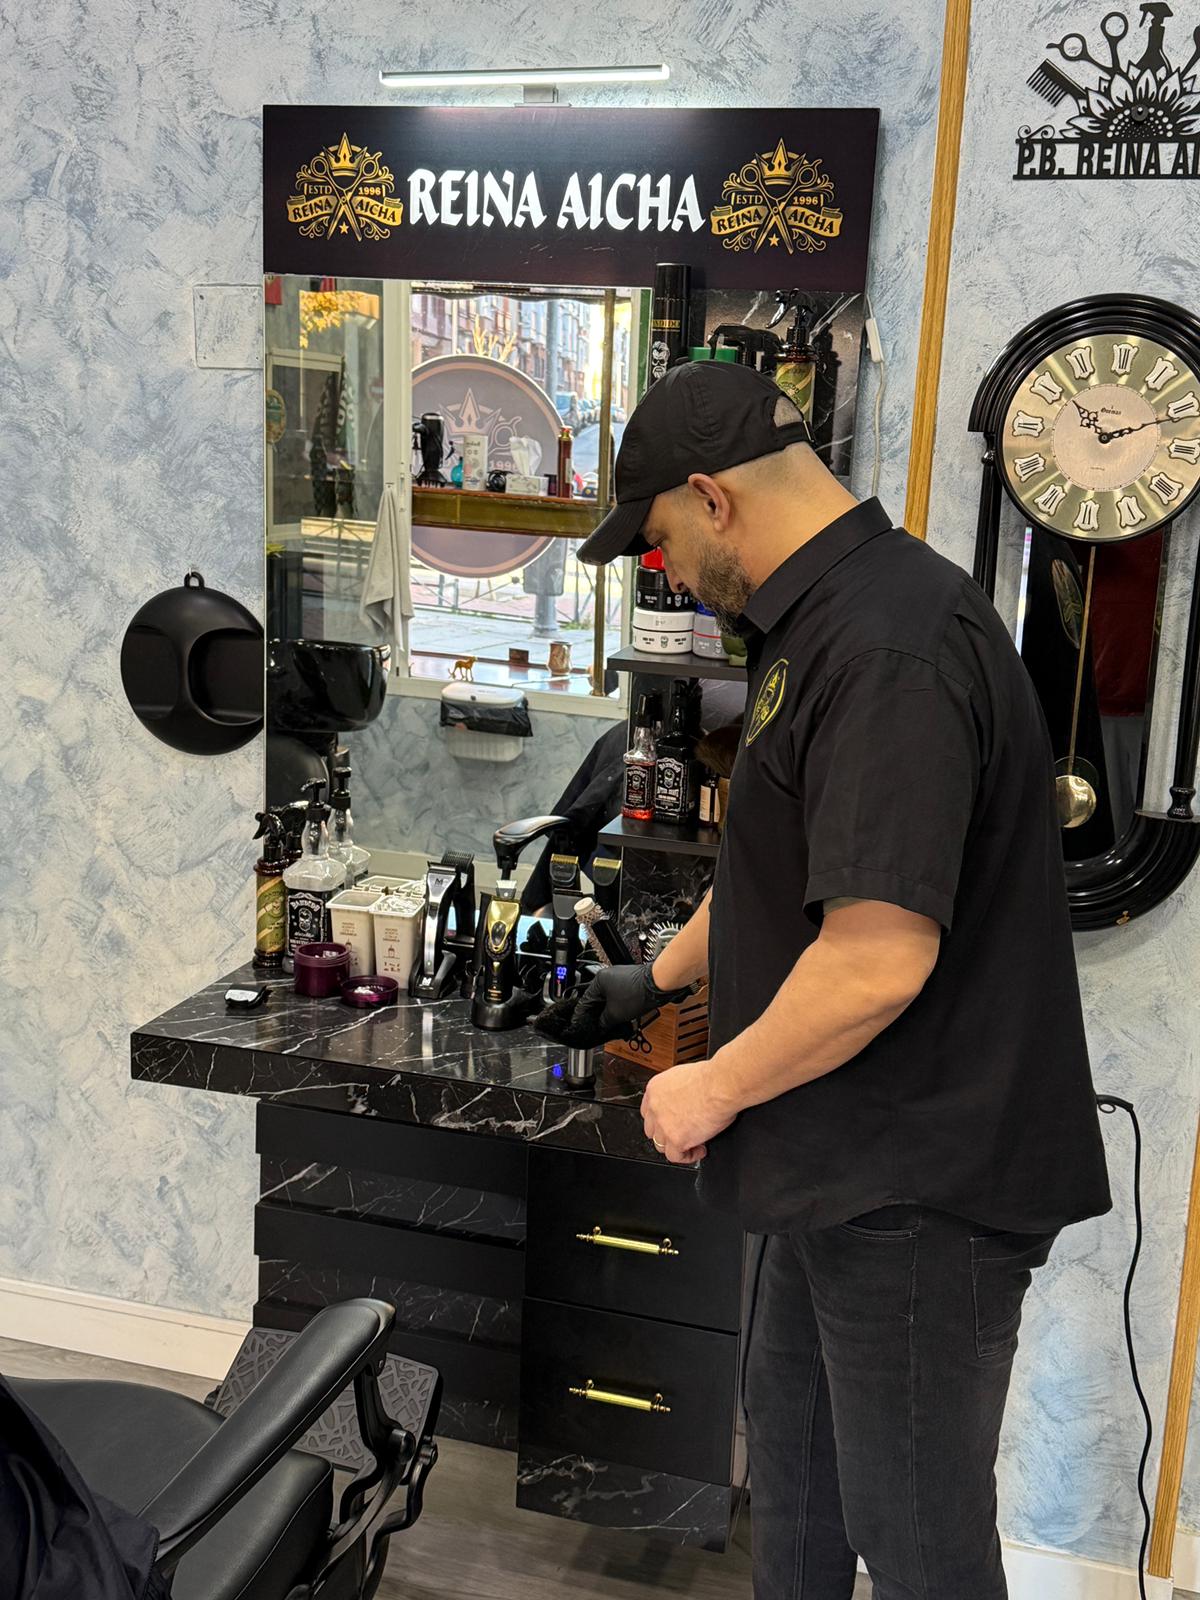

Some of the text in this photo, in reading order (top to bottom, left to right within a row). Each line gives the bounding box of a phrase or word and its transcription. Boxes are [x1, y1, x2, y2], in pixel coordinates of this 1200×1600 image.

[1016, 141, 1065, 177] P.B.
[1076, 141, 1162, 177] REINA
[309, 184, 381, 196] ESTD 1996
[407, 168, 706, 233] REINA AICHA
[736, 194, 818, 205] ESTD 1996
[292, 198, 396, 222] REINA AICHA
[716, 208, 834, 234] REINA AICHA
